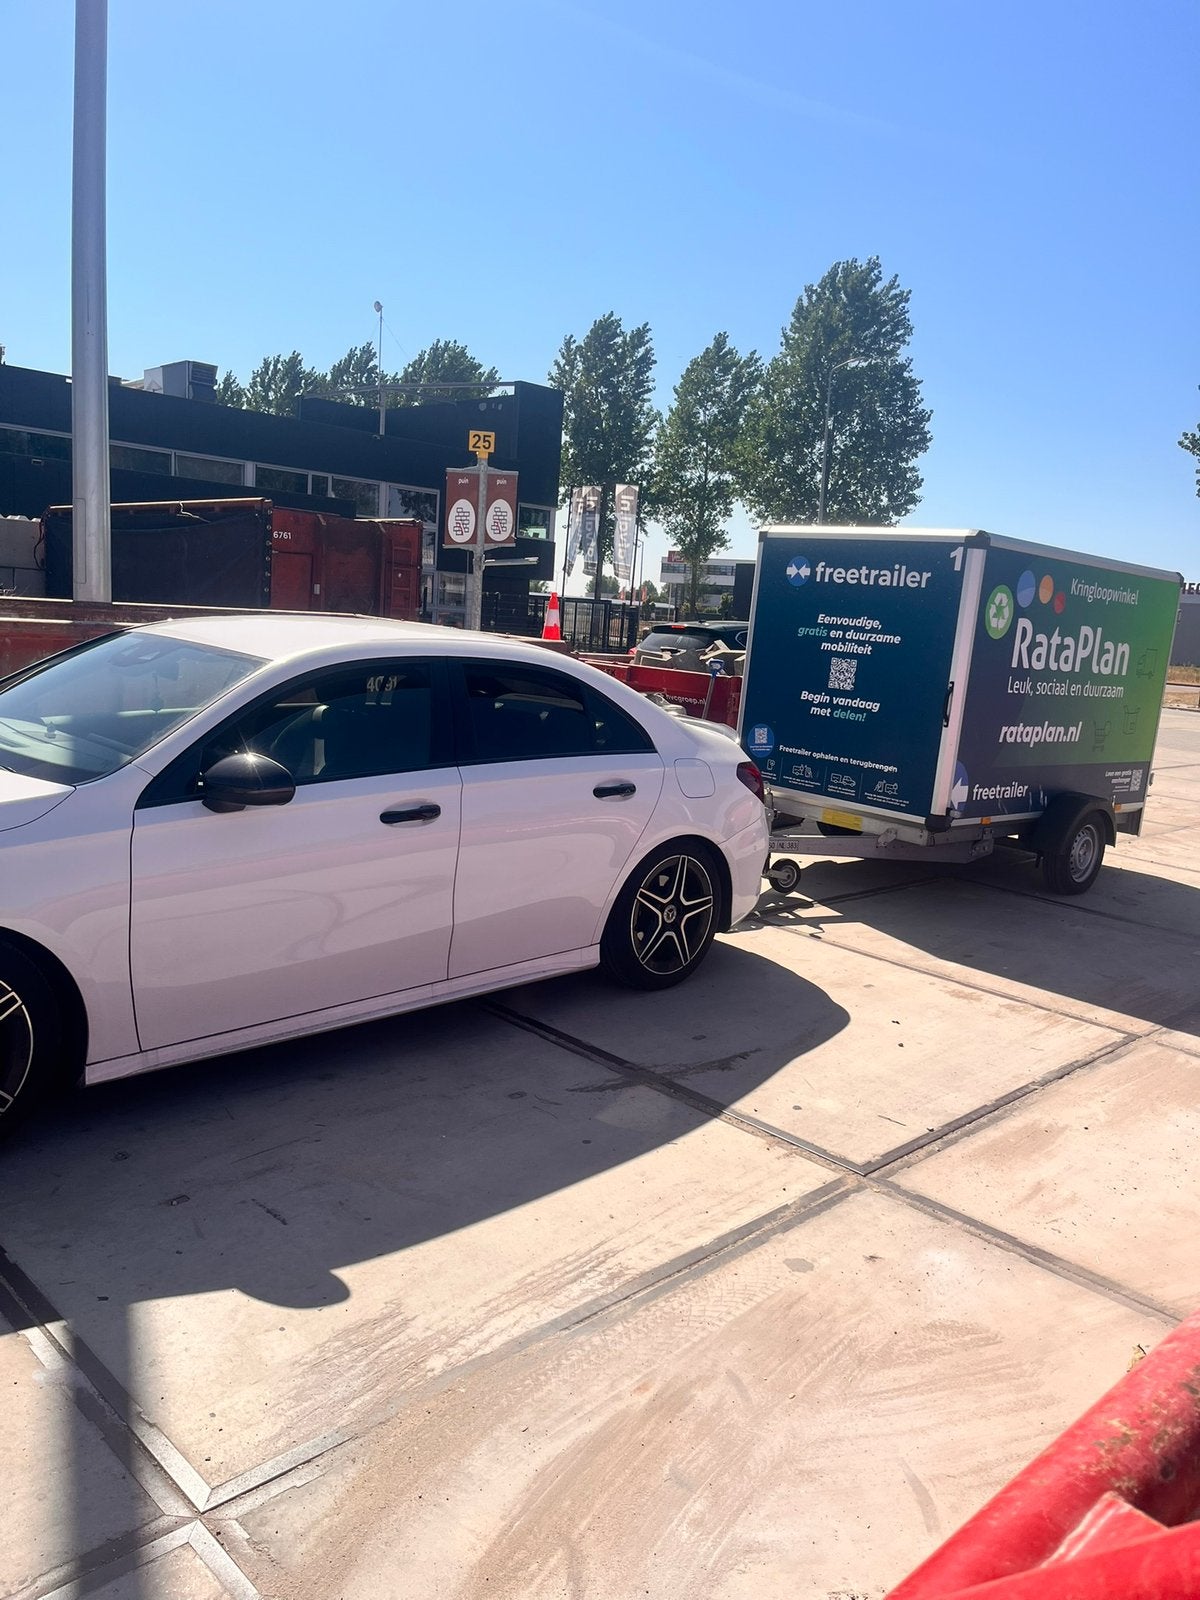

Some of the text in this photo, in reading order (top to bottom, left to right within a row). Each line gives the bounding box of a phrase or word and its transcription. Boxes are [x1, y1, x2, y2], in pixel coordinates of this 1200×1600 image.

[472, 434, 491, 449] 25
[273, 531, 291, 539] 6761
[950, 547, 964, 571] 1
[815, 561, 932, 588] freetrailer
[1071, 578, 1139, 605] Kringloopwinkel
[817, 614, 882, 630] Eenvoudige,
[798, 627, 901, 644] gratis en duurzame
[820, 642, 872, 655] mobiliteit
[1011, 618, 1130, 676] RataPlan
[1007, 676, 1124, 698] Leuk, sociaal en duurzaam
[800, 691, 881, 712] Begin vandaag
[810, 706, 867, 721] met delen!
[999, 721, 1083, 747] rataplan.nl
[779, 745, 812, 756] Freetrailer
[812, 752, 839, 762] ophalen
[850, 758, 898, 773] terugbrengen
[972, 781, 1029, 801] freetrailer
